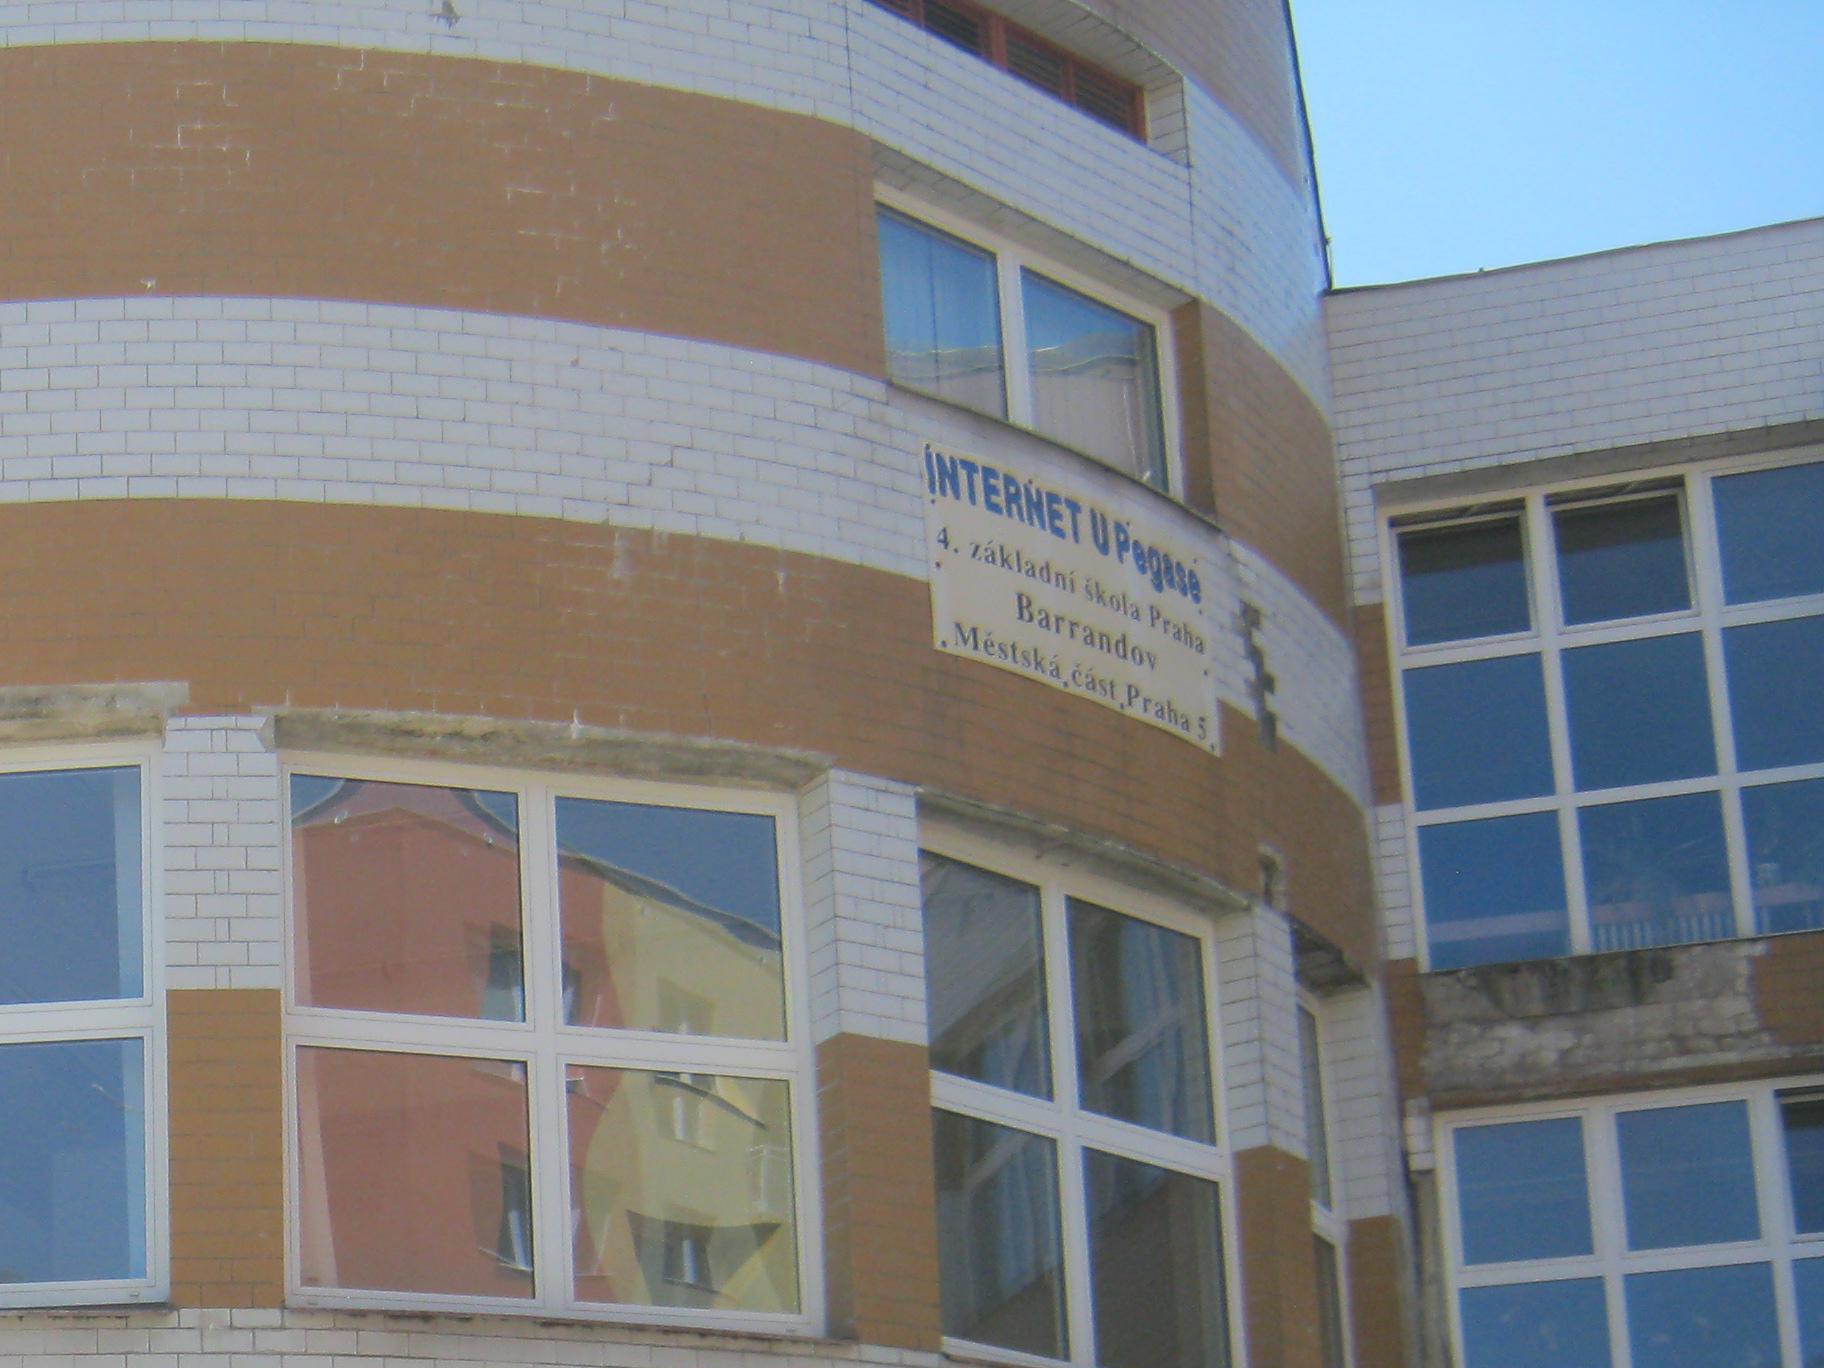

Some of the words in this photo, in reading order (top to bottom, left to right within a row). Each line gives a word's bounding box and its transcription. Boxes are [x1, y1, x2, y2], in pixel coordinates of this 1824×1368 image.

[925, 446, 1082, 544] INTERNET
[1090, 507, 1111, 556] U
[1114, 521, 1201, 605] Pegase
[937, 527, 959, 554] 4.
[970, 540, 1075, 594] základní
[1084, 577, 1141, 622] škola
[1149, 604, 1205, 655] Praha
[1015, 589, 1157, 672] Barrandov
[954, 621, 1062, 680] Městská
[1071, 663, 1115, 701] část
[1127, 683, 1190, 733] Praha
[1197, 716, 1208, 741] 5
